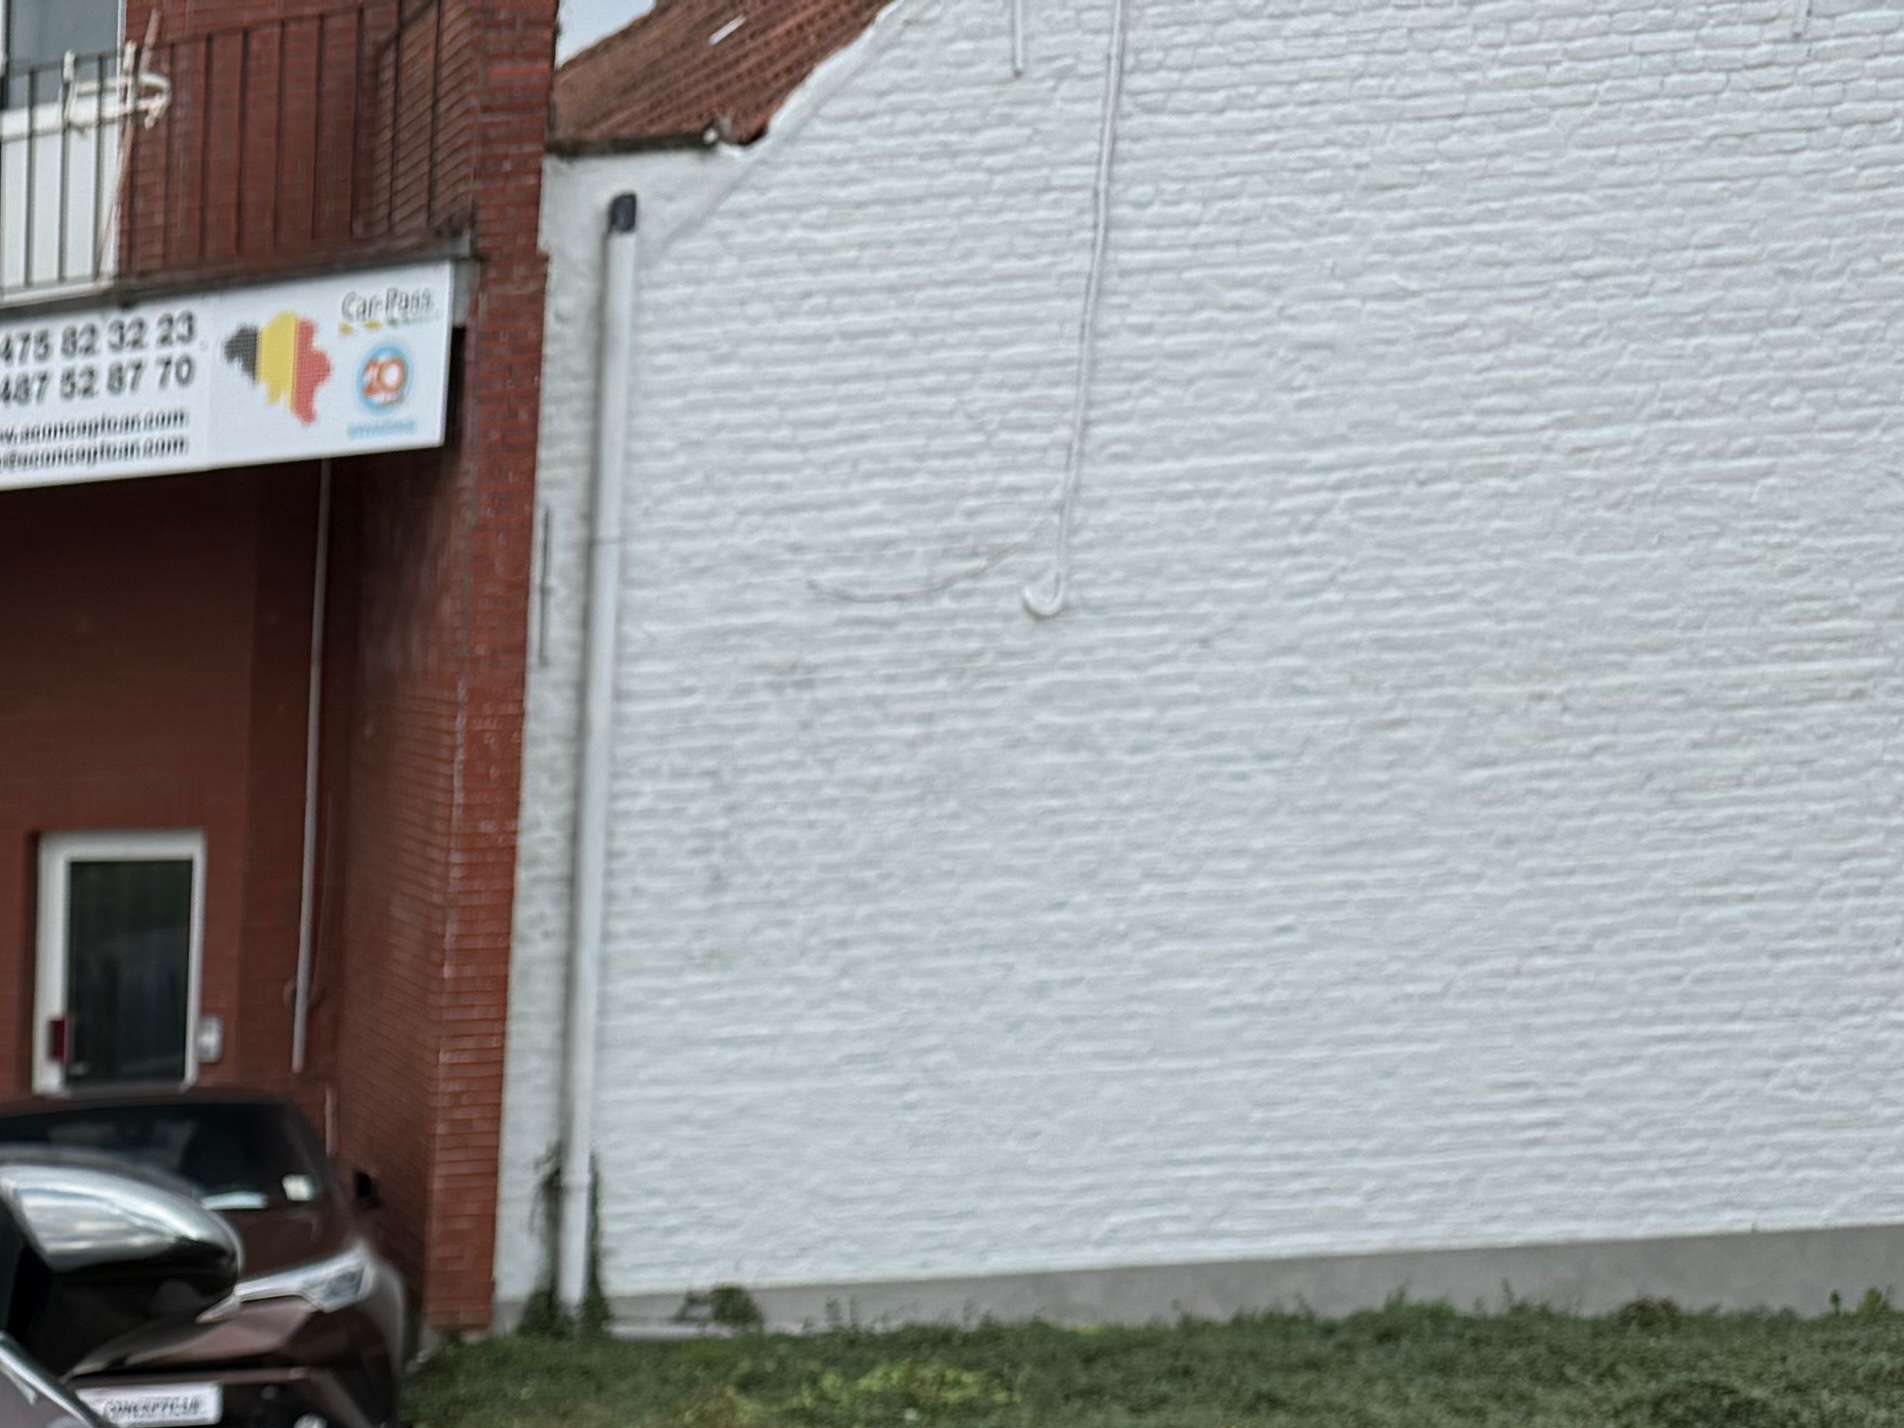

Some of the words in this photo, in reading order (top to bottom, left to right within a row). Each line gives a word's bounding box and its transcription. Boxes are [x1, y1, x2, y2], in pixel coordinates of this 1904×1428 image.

[341, 287, 433, 320] Car-Pass
[62, 323, 98, 359] 82
[107, 318, 146, 351] 32
[157, 310, 198, 346] 23
[60, 365, 98, 400] 52
[106, 360, 144, 395] 87
[156, 354, 196, 390] 70
